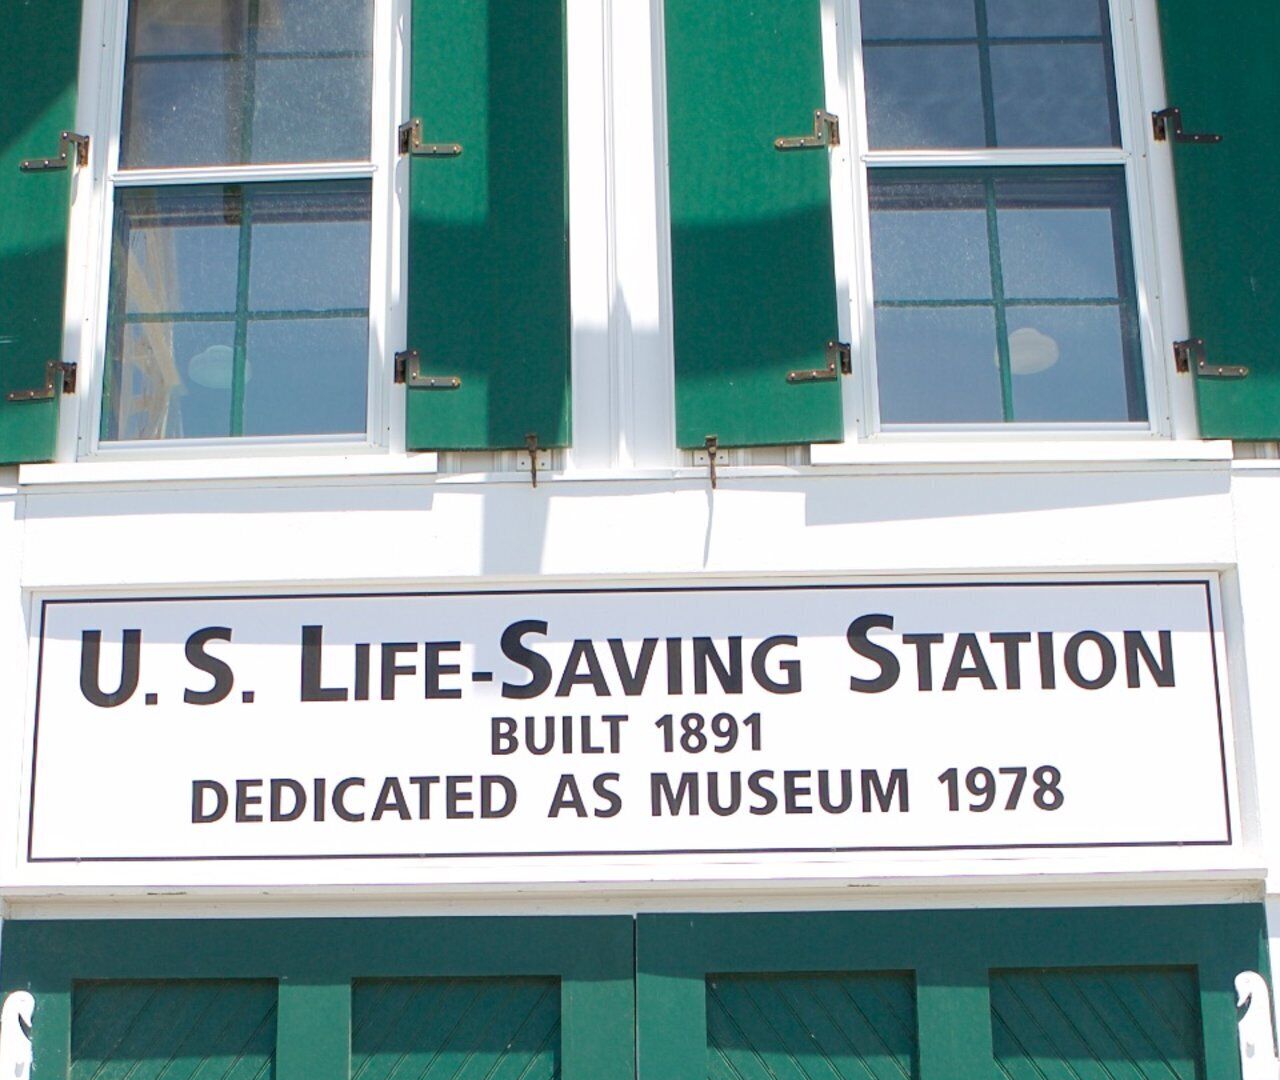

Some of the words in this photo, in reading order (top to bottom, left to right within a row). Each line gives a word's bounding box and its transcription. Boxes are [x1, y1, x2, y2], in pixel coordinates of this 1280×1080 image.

[846, 613, 1176, 694] STATION
[491, 714, 629, 756] BUILT
[654, 712, 762, 754] 1891
[191, 775, 517, 824] DEDICATED
[547, 772, 622, 819] AS
[650, 769, 909, 817] MUSEUM
[938, 766, 1064, 813] 1978
